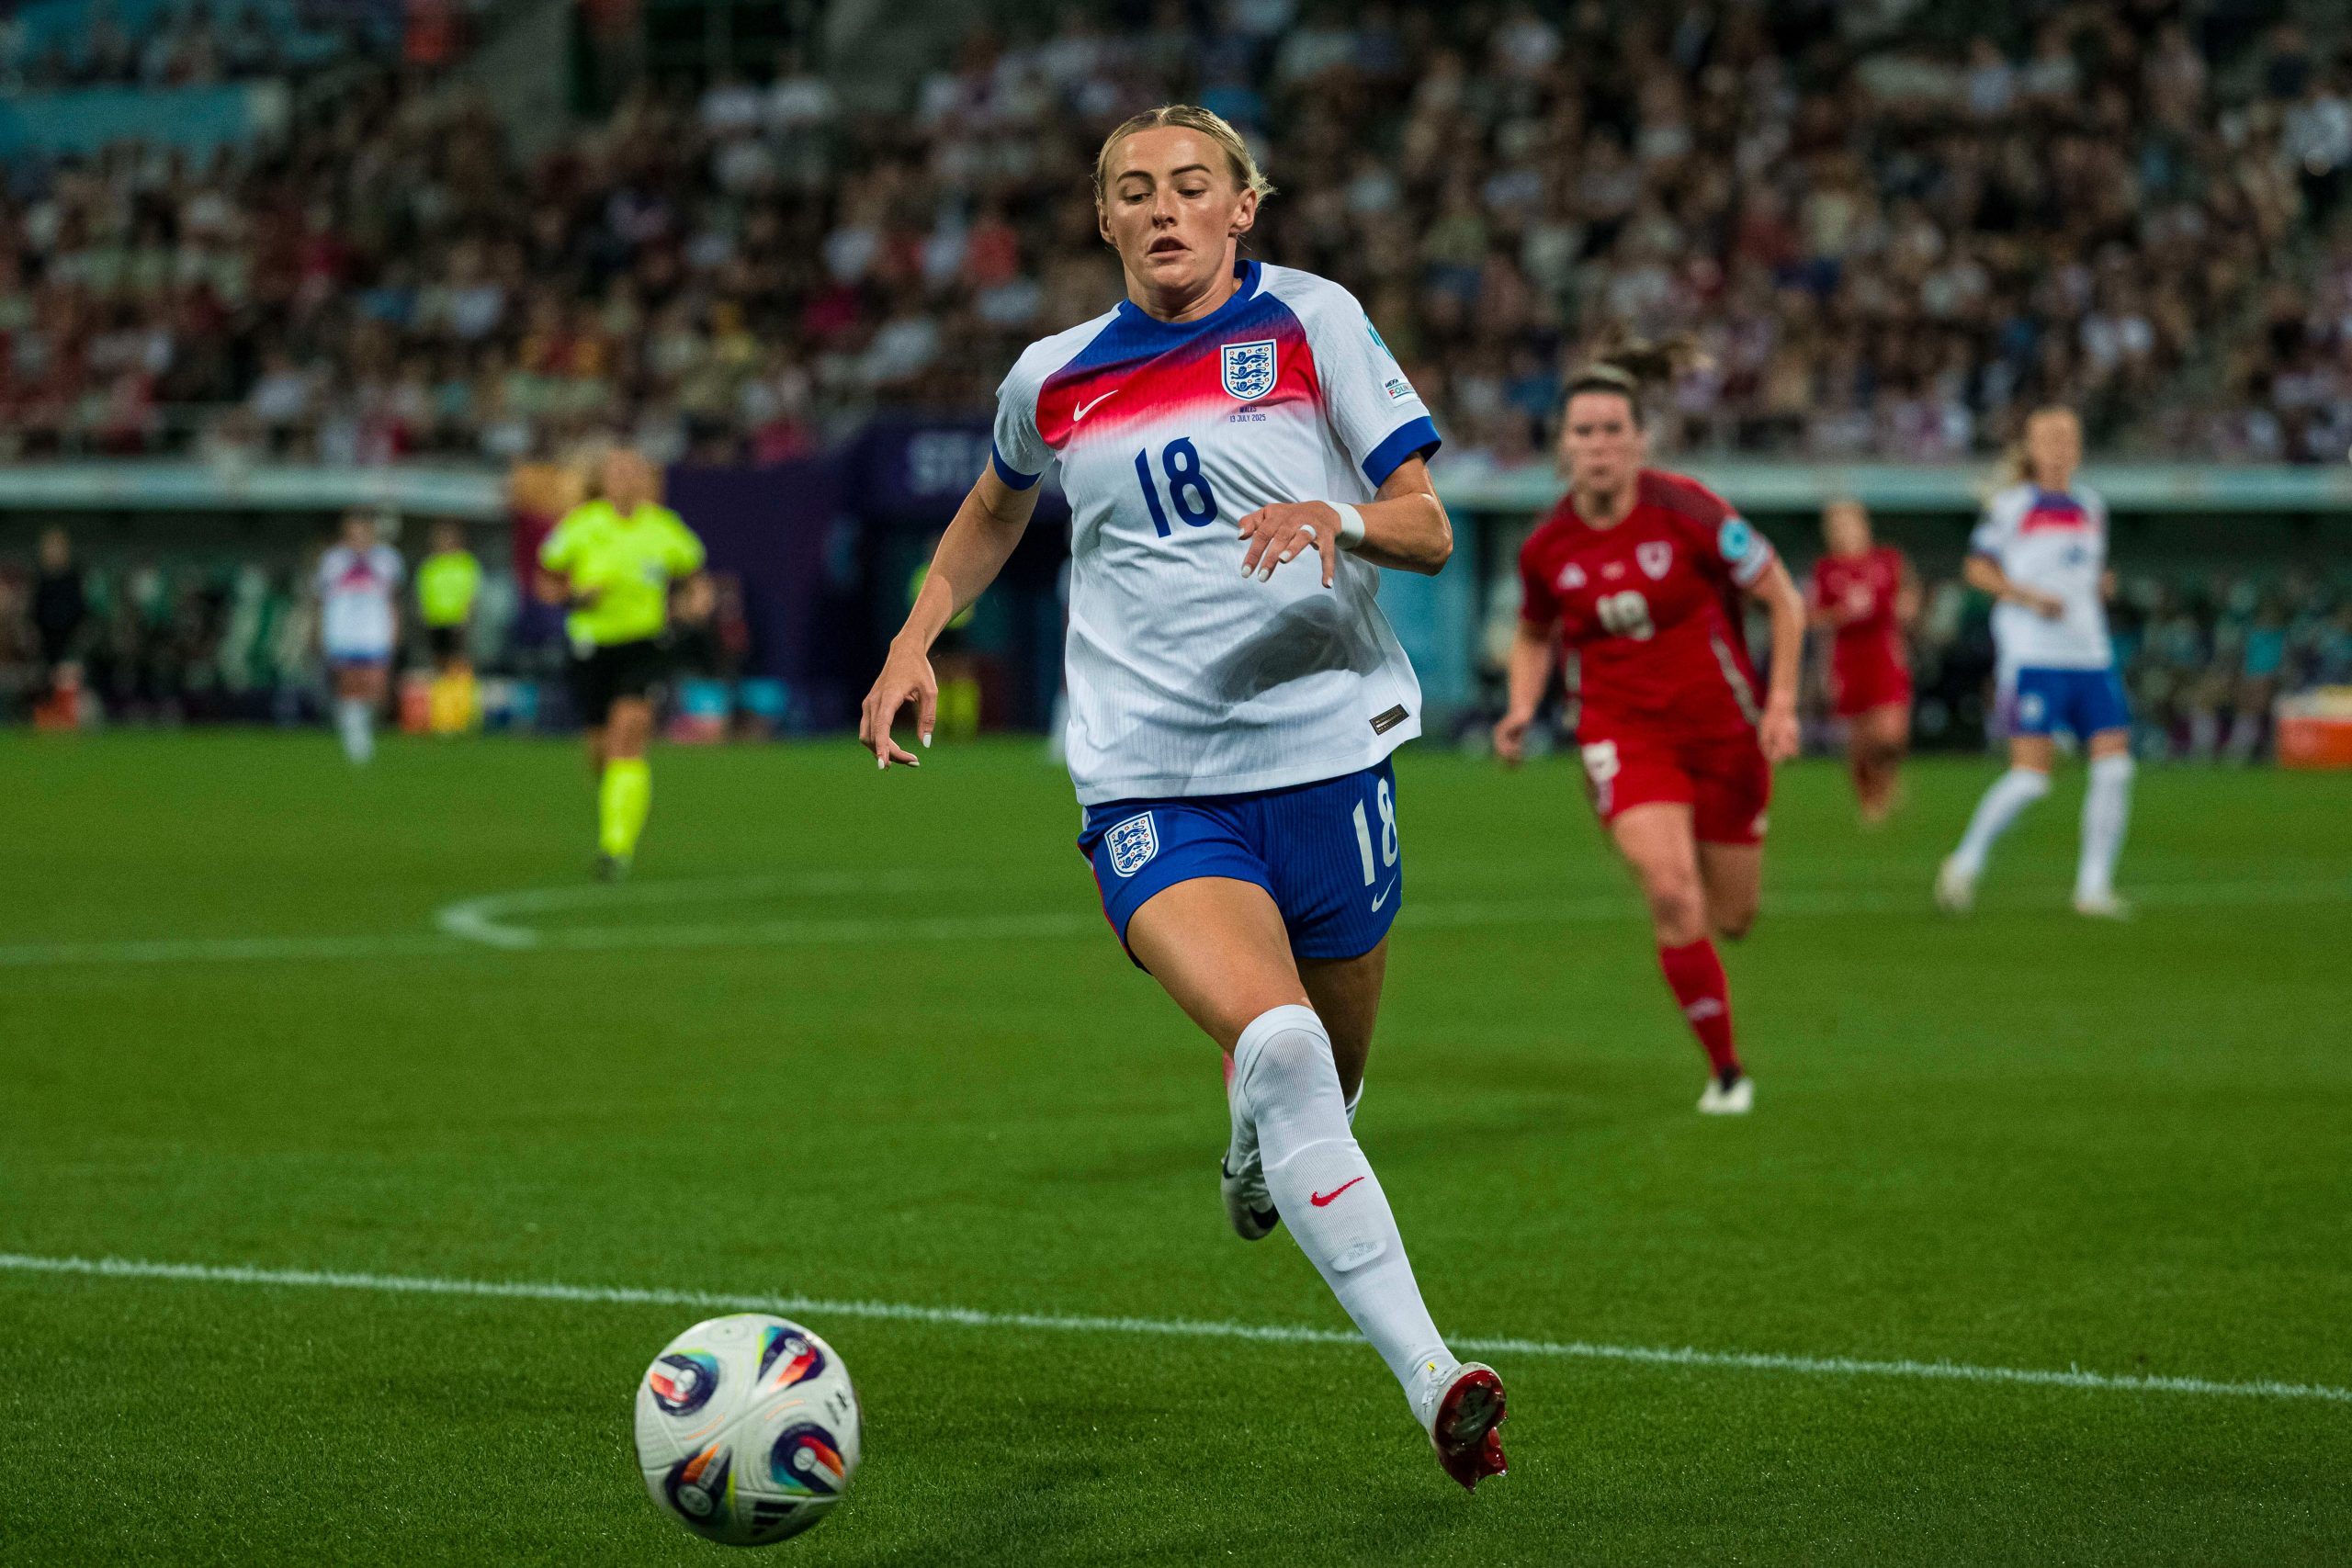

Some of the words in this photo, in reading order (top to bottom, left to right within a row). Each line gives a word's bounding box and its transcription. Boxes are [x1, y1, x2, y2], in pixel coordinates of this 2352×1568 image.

[1229, 414, 1236, 423] 13
[1237, 414, 1250, 423] JULY
[1251, 413, 1267, 422] 2025
[1239, 405, 1257, 413] WALES
[1134, 436, 1218, 538] 18
[1352, 777, 1397, 886] 18
